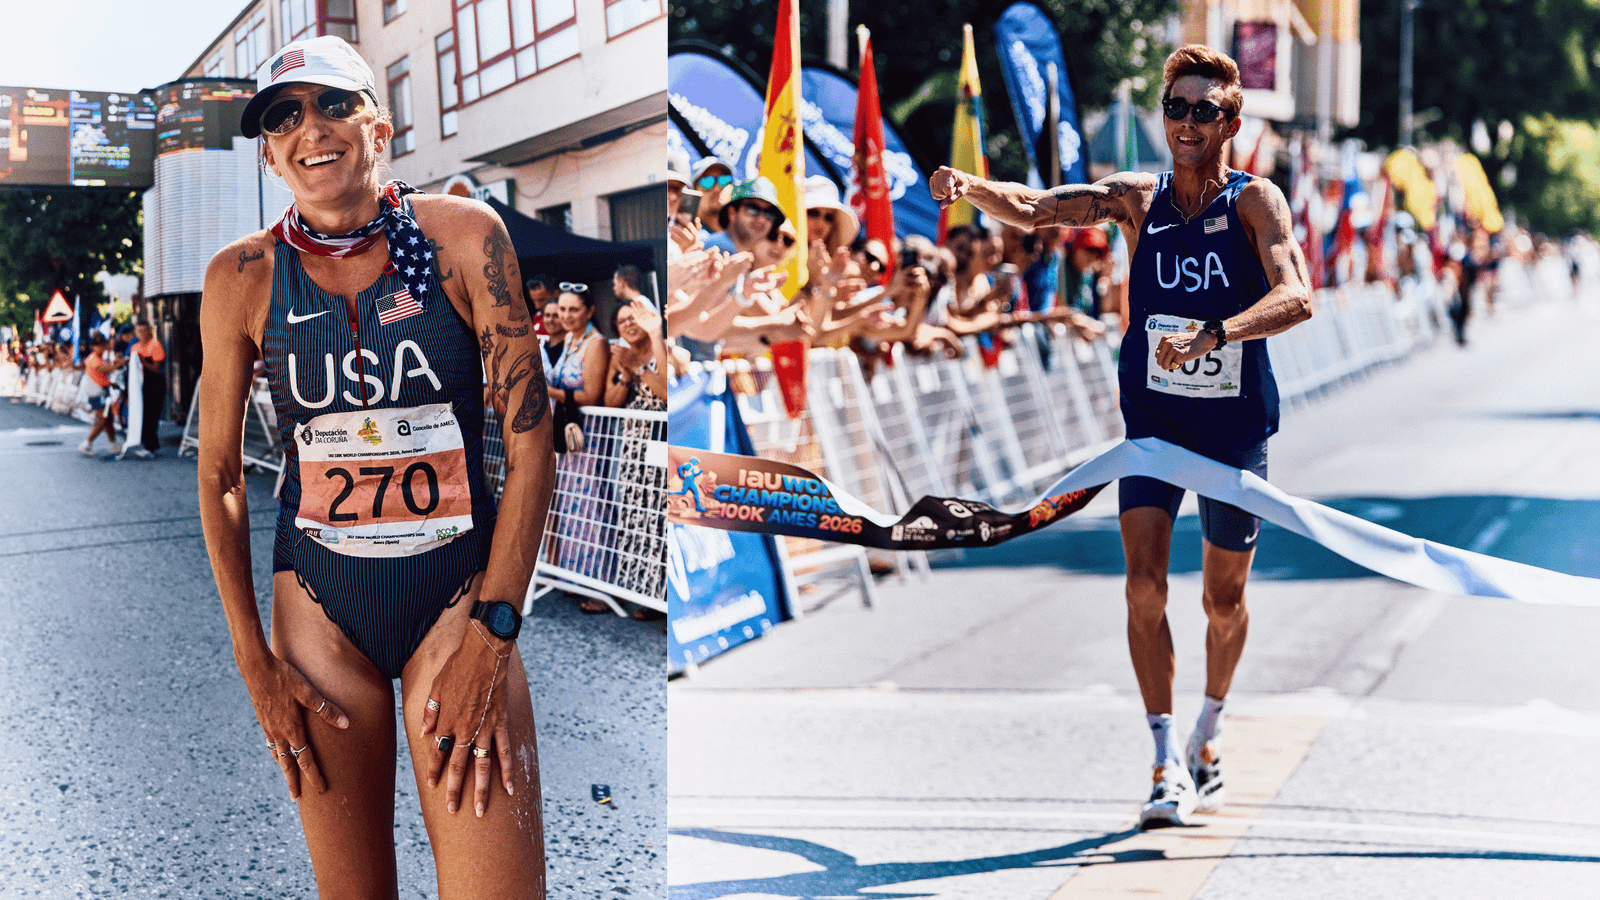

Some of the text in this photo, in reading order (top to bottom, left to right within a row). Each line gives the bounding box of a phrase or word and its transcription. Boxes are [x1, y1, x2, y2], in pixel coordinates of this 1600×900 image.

[1156, 252, 1230, 292] USA
[288, 340, 442, 409] USA
[315, 429, 348, 437] Deputación
[324, 436, 348, 444] CORUÑA
[325, 461, 440, 522] 270
[713, 484, 843, 515] CHAMPIONS
[719, 502, 863, 534] 100K AMES 2026
